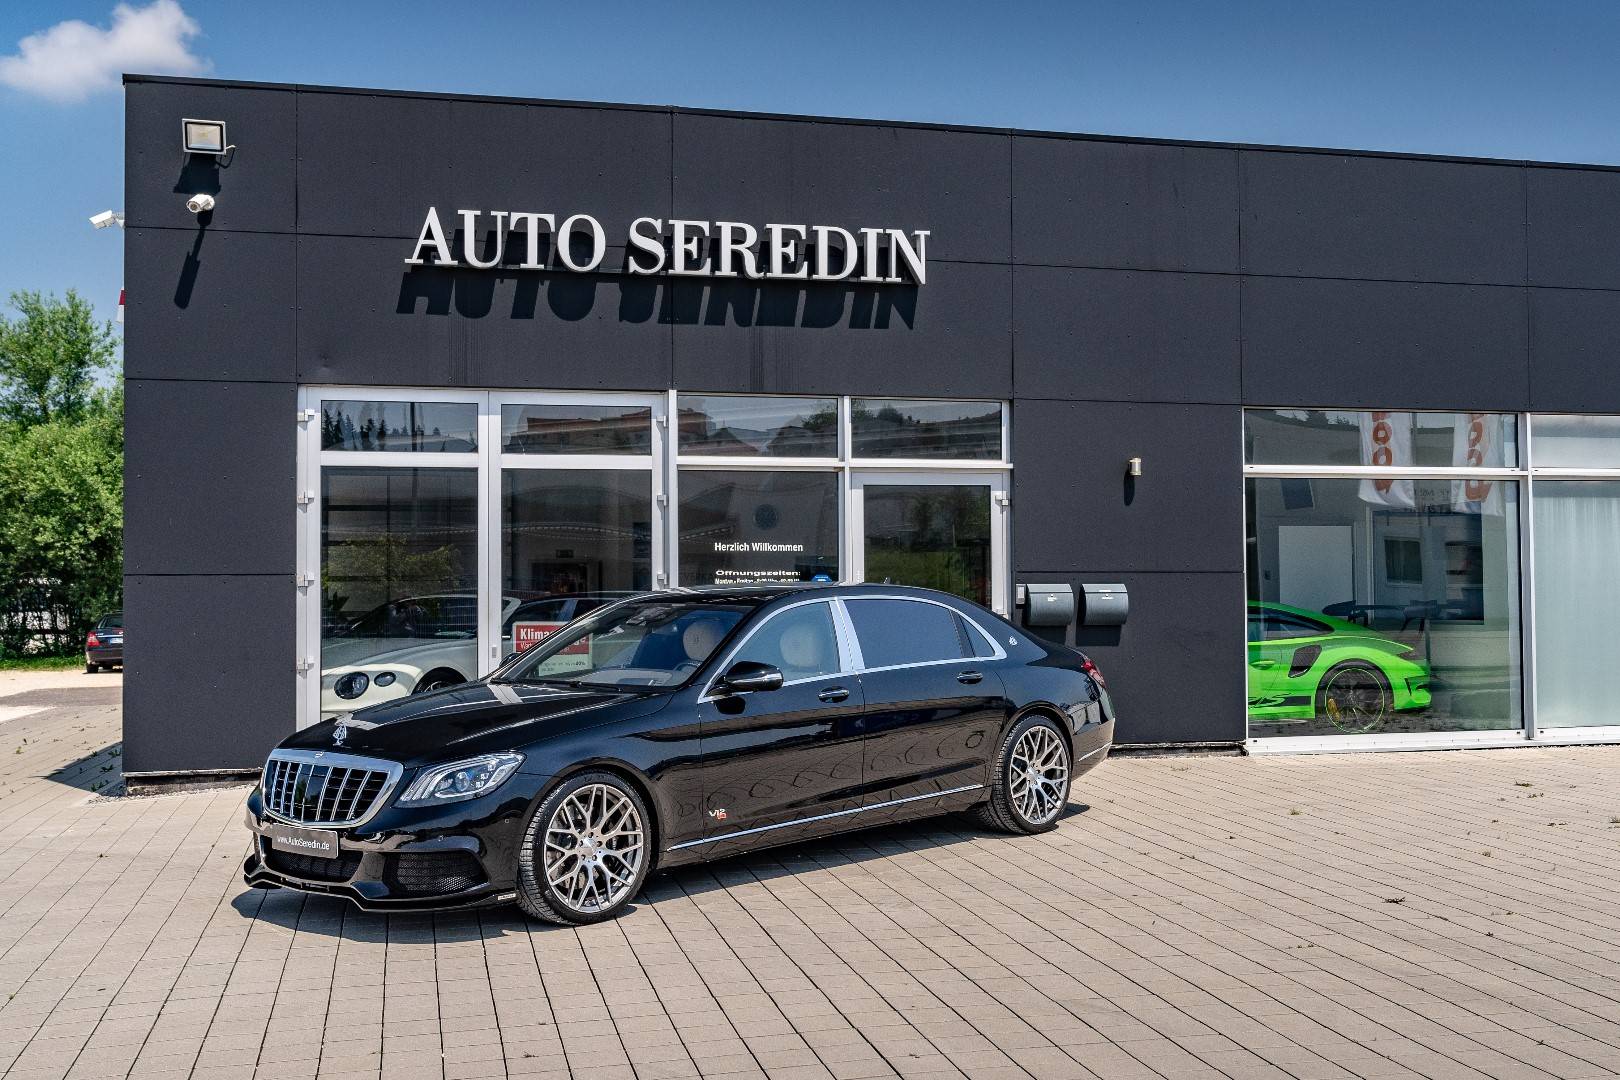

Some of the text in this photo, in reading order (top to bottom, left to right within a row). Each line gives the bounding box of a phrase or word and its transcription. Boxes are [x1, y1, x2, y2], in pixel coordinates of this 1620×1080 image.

[404, 206, 931, 285] AUTO SEREDIN
[714, 542, 804, 552] Herzlich Willkommen
